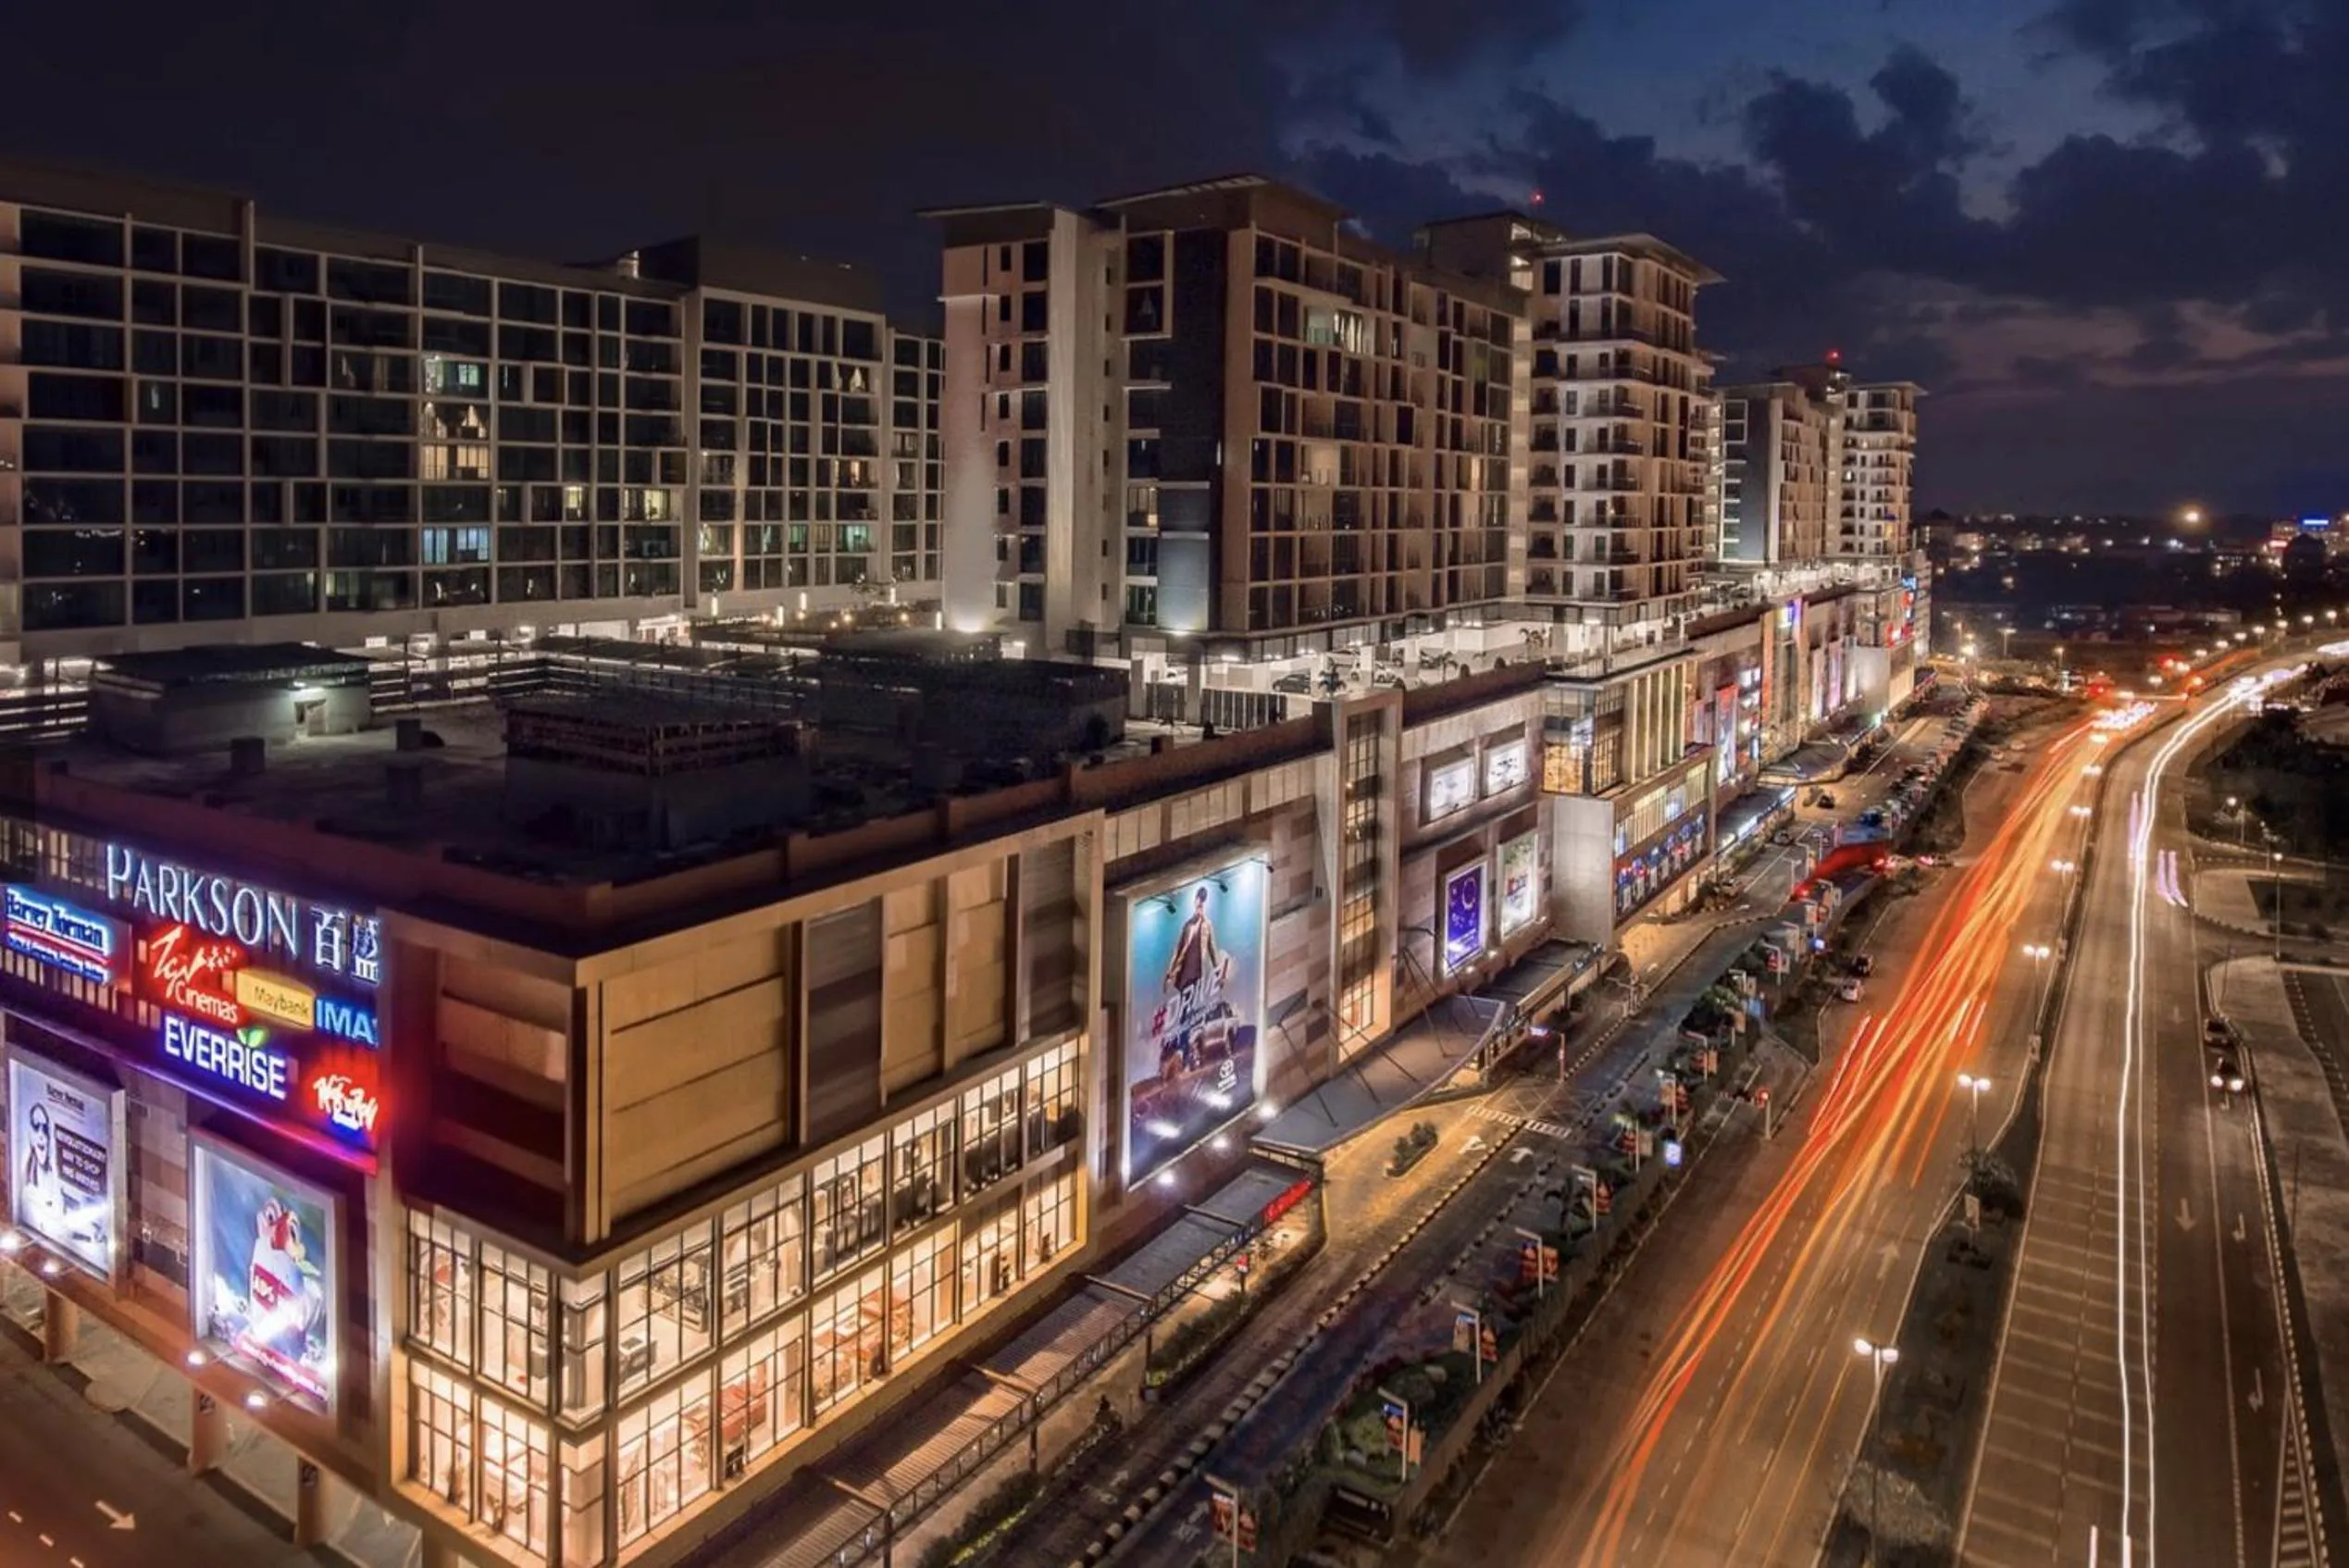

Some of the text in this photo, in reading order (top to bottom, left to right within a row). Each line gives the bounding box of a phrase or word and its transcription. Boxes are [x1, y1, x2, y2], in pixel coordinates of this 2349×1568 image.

[106, 843, 299, 957] PARKSON
[174, 980, 239, 1025] Cinemas
[254, 985, 310, 1019] Maybank
[165, 1014, 287, 1101] EVERRISE
